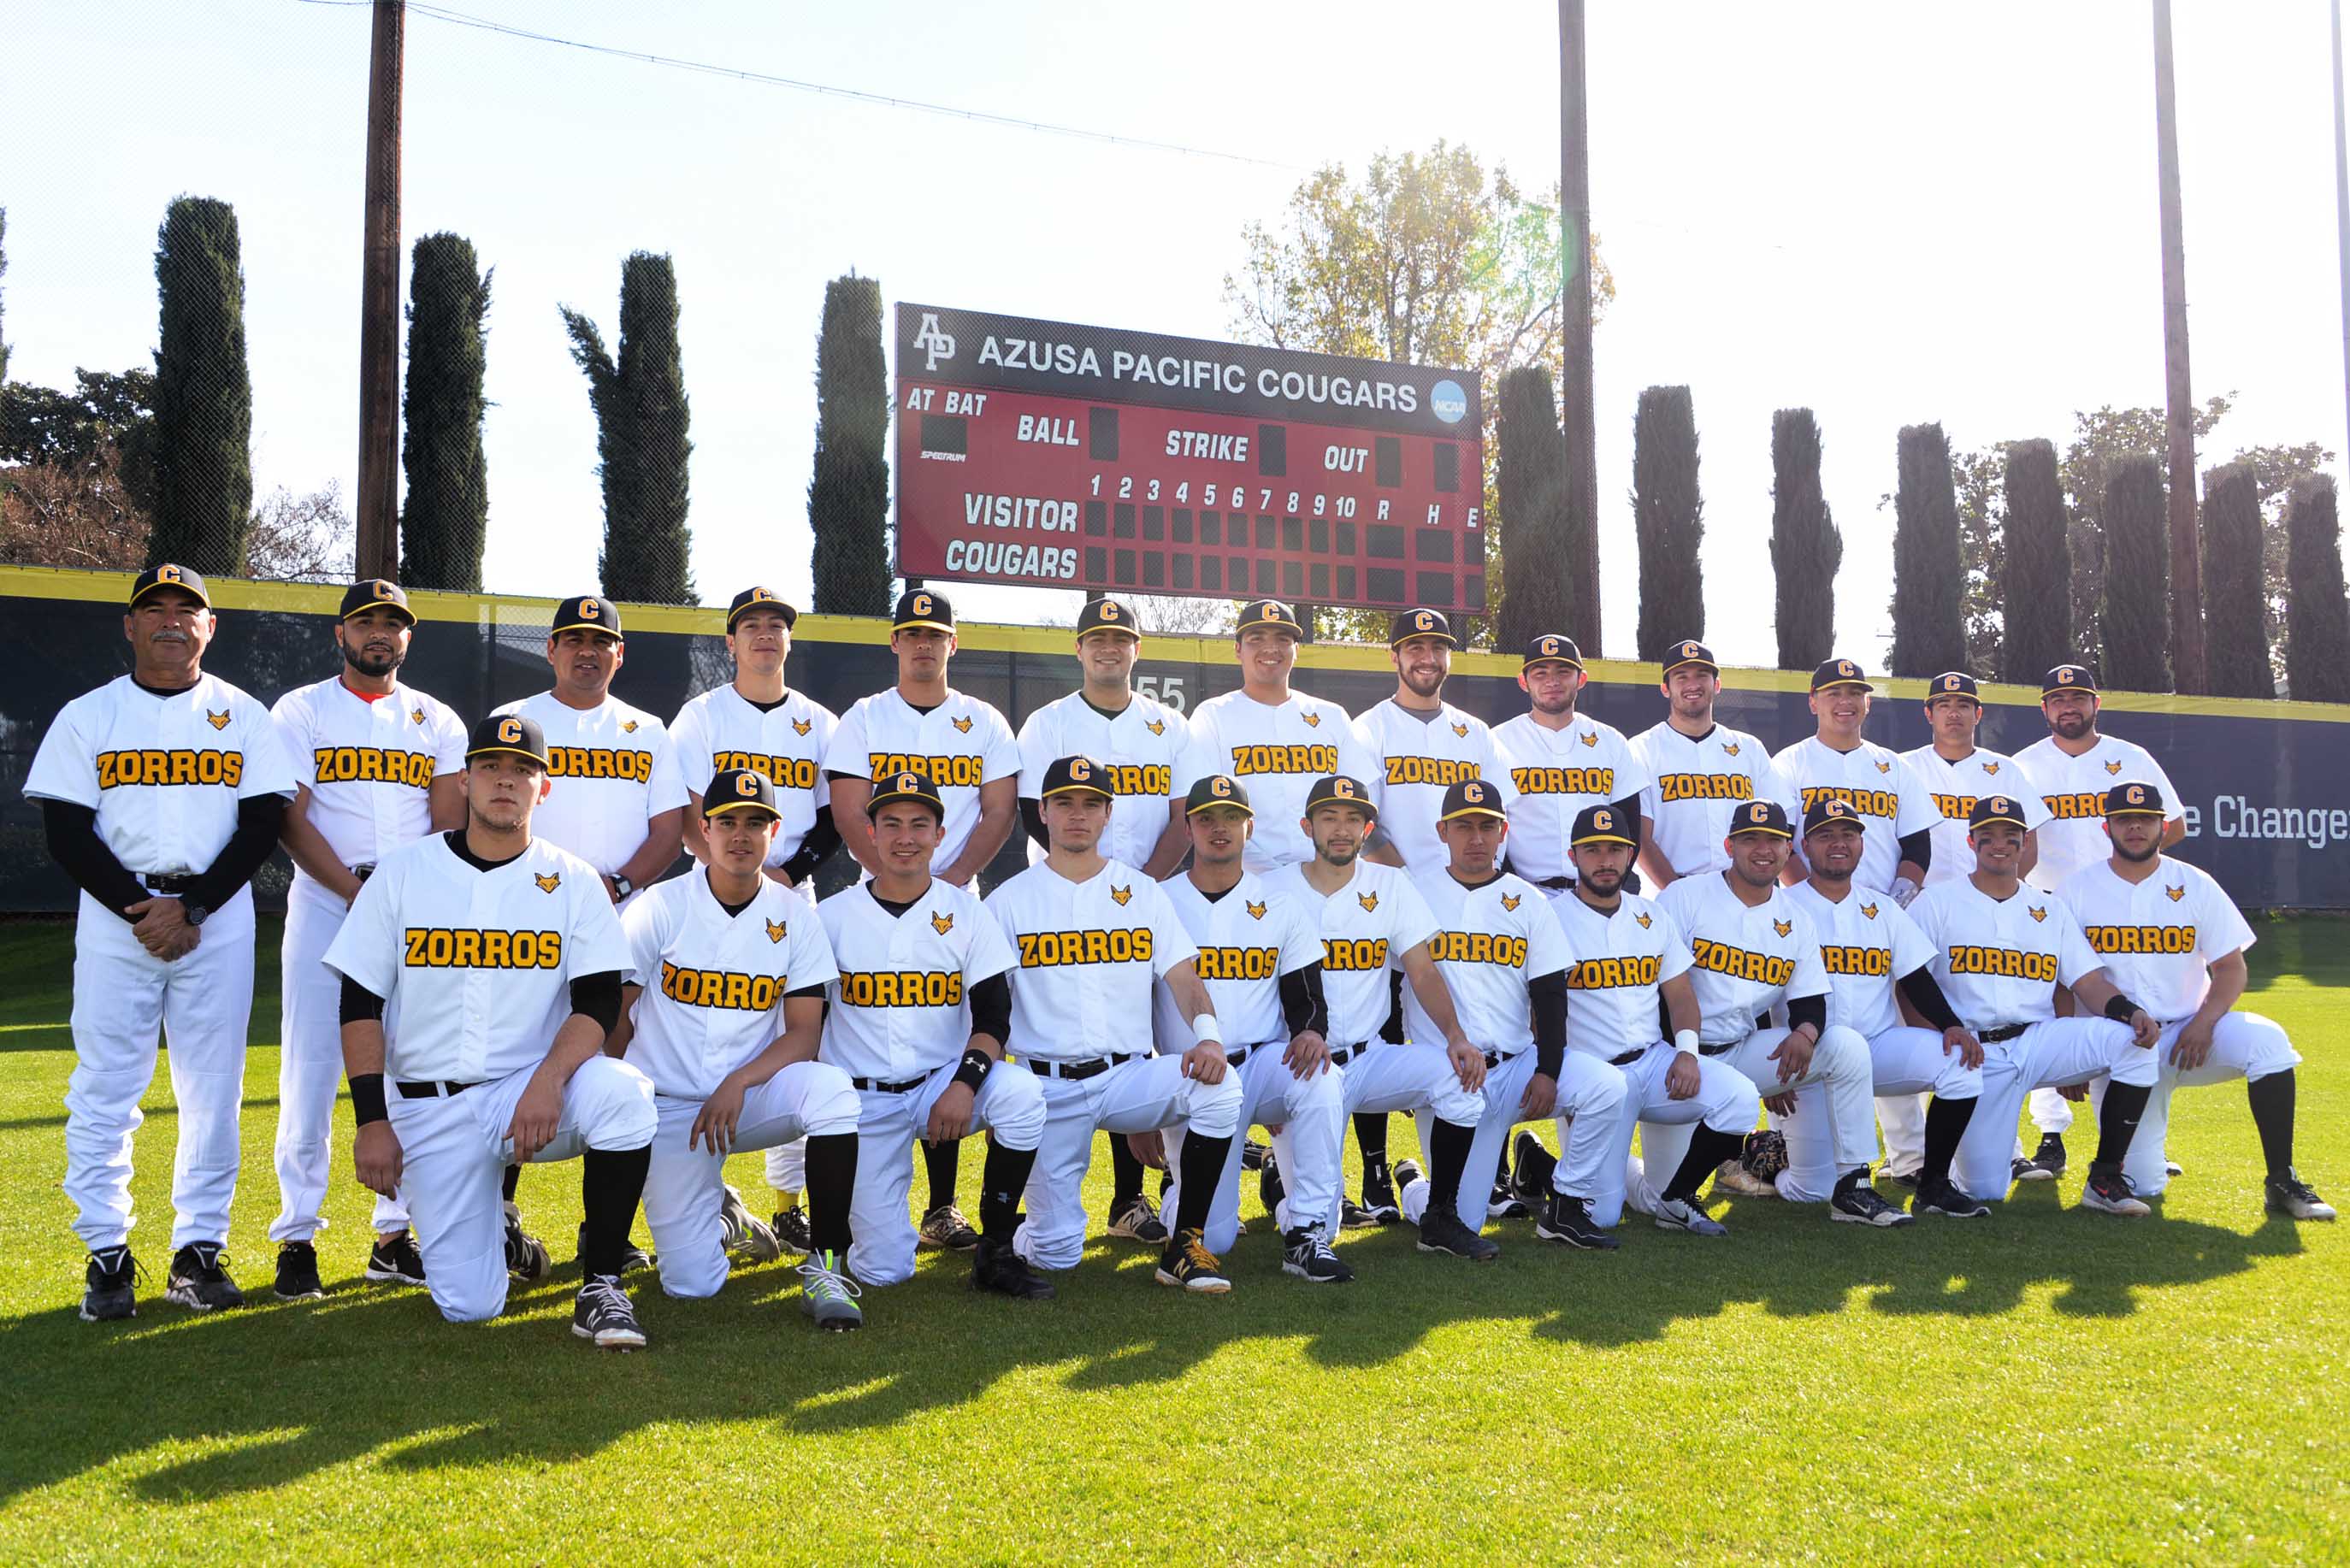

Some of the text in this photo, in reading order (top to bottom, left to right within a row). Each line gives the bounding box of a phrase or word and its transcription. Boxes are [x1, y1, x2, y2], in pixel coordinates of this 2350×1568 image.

[978, 335, 1417, 412] AZUSA PACIFIC COUGARS
[906, 388, 987, 416] AT BAT
[1017, 415, 1080, 445] BALL
[920, 451, 965, 463] SPECTRUM
[1166, 429, 1249, 462] STRIKE
[1325, 445, 1368, 472] OUT
[965, 492, 1078, 532] VISITOR
[1091, 475, 1479, 528] 1 2 3 4 5 6 7 8 9 10 R H E
[946, 539, 1078, 579] COUGARS
[157, 564, 180, 582] C
[373, 581, 393, 600] C
[753, 587, 771, 600] C
[579, 598, 599, 619] C
[913, 595, 932, 616] C
[1100, 602, 1119, 621] C
[1262, 603, 1279, 621] C
[1415, 611, 1433, 631] C
[1541, 638, 1559, 656] C
[1682, 642, 1699, 658] C
[1838, 660, 1855, 677] C
[2056, 668, 2074, 684] C
[1945, 675, 1961, 691] C
[499, 718, 522, 743] C
[97, 749, 244, 790] ZORROS
[315, 747, 436, 789] ZORROS
[547, 746, 652, 784] ORROS
[1069, 758, 1090, 781] C
[1231, 745, 1337, 775] ZORROS
[736, 773, 758, 797] C
[897, 773, 918, 793] C
[1105, 764, 1171, 796] RROS
[1211, 777, 1231, 797] C
[1334, 779, 1354, 799] C
[1464, 783, 1484, 803] C
[1511, 768, 1614, 795] ZORROS
[1660, 774, 1753, 802] ZORROS
[1826, 800, 1844, 817] C
[1991, 797, 2009, 814] C
[2127, 786, 2145, 805] C
[1594, 811, 1612, 830] C
[1750, 804, 1768, 822] C
[2214, 795, 2350, 848] Change
[405, 928, 561, 969] ZORROS
[1017, 928, 1152, 968] ZORROS
[1427, 932, 1527, 969] ORROS
[2085, 926, 2196, 953] ZORROS
[1192, 946, 1278, 980] RROS
[1692, 938, 1795, 986] ZORROS
[1820, 945, 1891, 976] RROS
[1949, 946, 2058, 981] ZORROS
[661, 959, 787, 1011] ZORROS
[840, 971, 962, 1007] ZORROS
